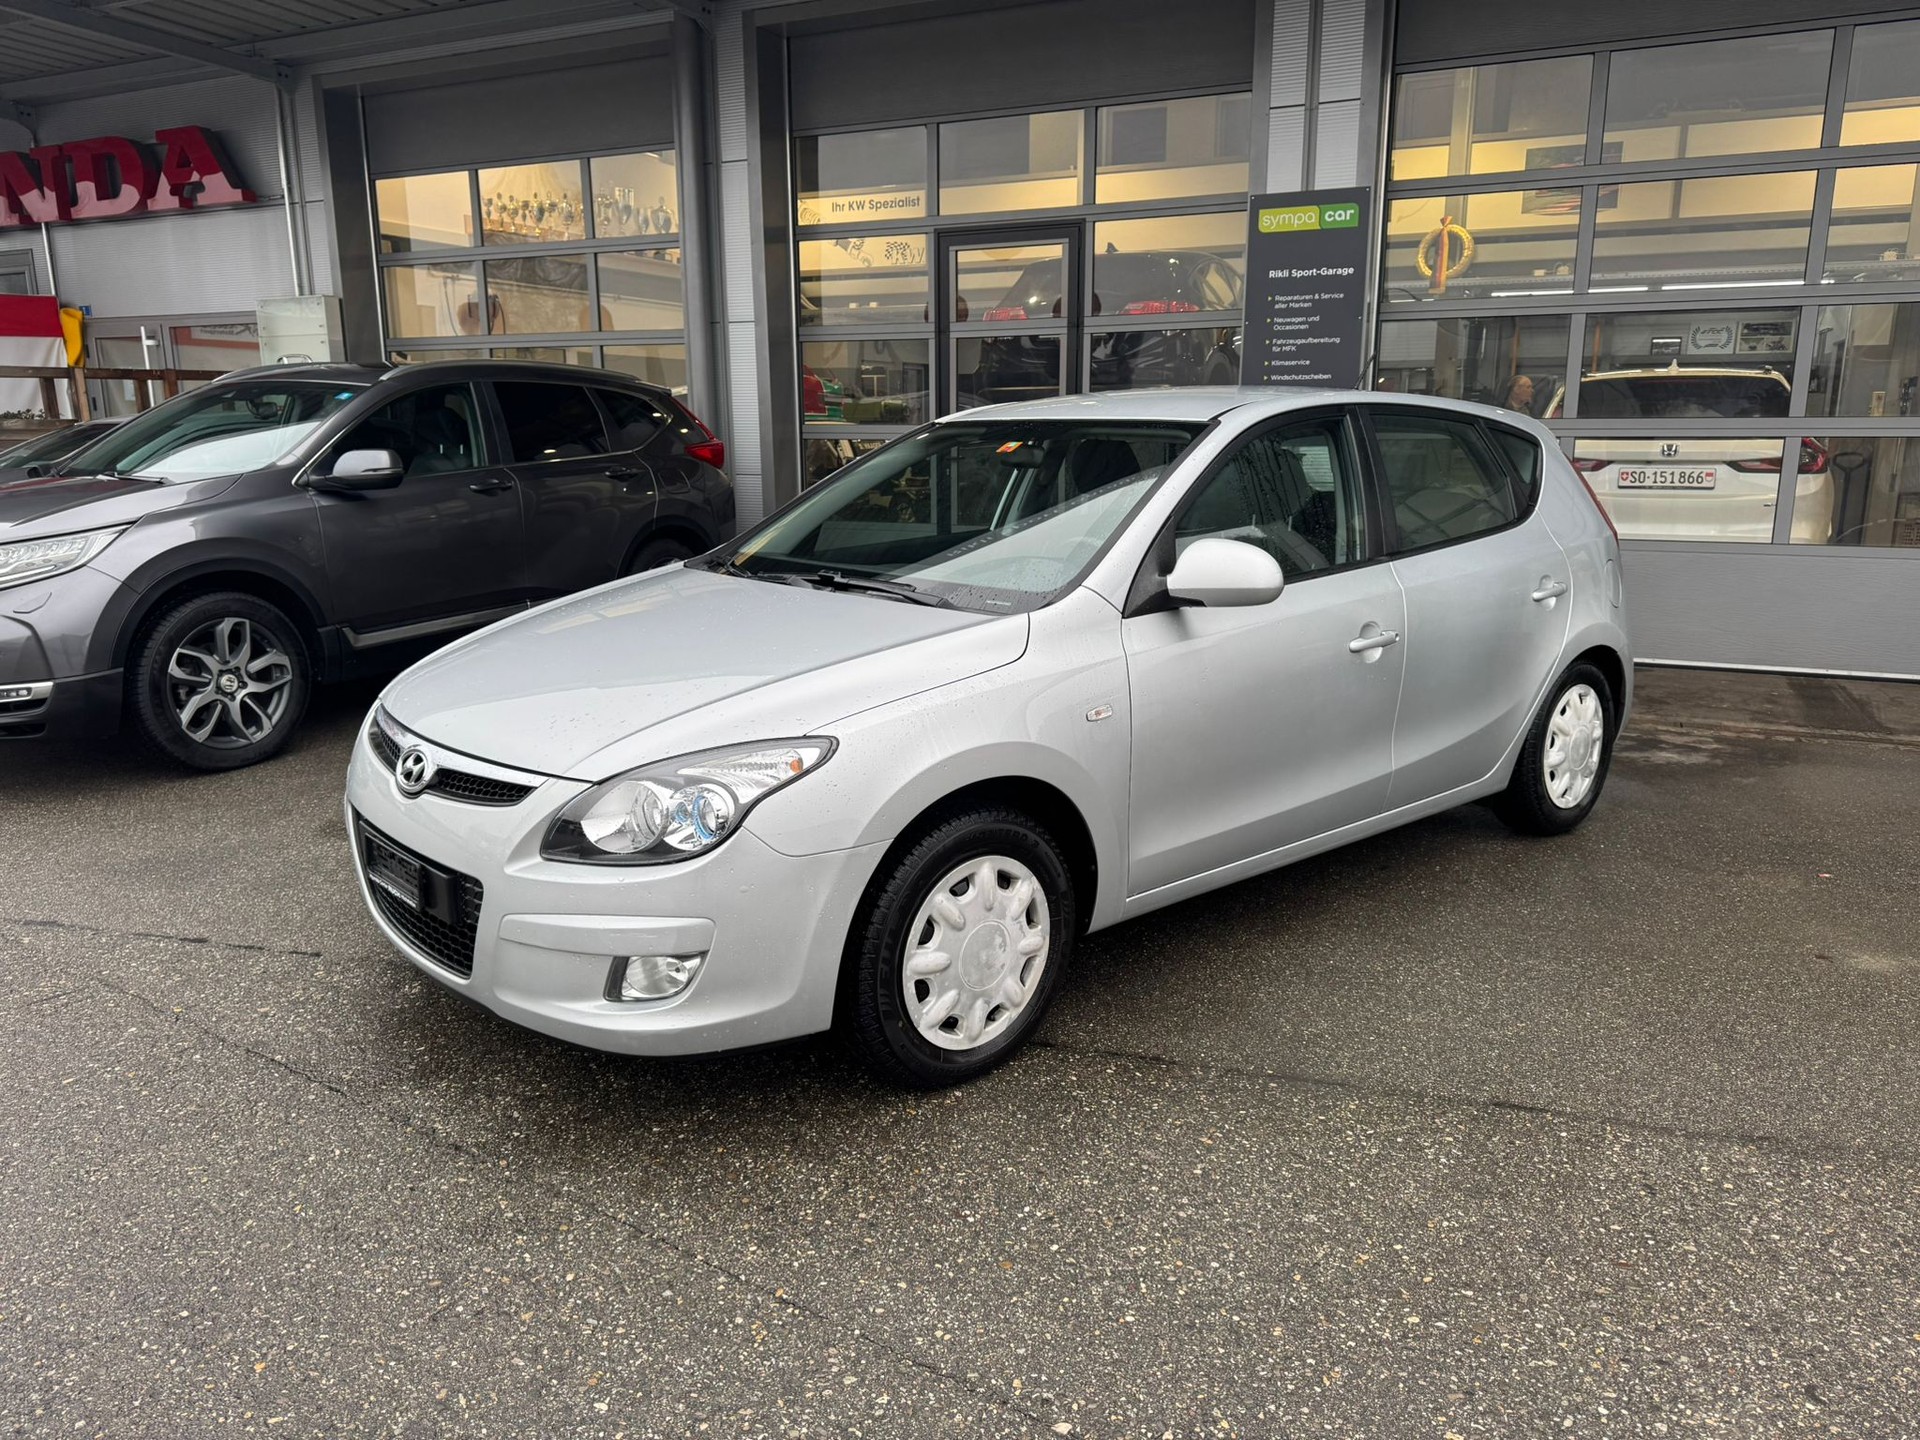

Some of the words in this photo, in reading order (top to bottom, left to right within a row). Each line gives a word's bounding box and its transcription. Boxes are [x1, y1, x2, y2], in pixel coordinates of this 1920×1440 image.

[831, 202, 845, 213] Ihr
[848, 200, 866, 211] KW
[868, 196, 920, 212] Spezialist
[1262, 211, 1316, 230] sympa
[1324, 208, 1355, 223] car
[1268, 268, 1290, 279] Rikli
[1291, 266, 1355, 278] Sport-Garage
[1274, 293, 1314, 303] Reparaturen
[1320, 292, 1344, 300] Service
[1273, 316, 1307, 325] Neuwagen
[1273, 323, 1309, 331] Occasionen
[1272, 336, 1341, 346] Fahrzeugaufbereitung
[1271, 358, 1311, 367] Klimaservice
[1270, 373, 1332, 381] Windschutzscheiben
